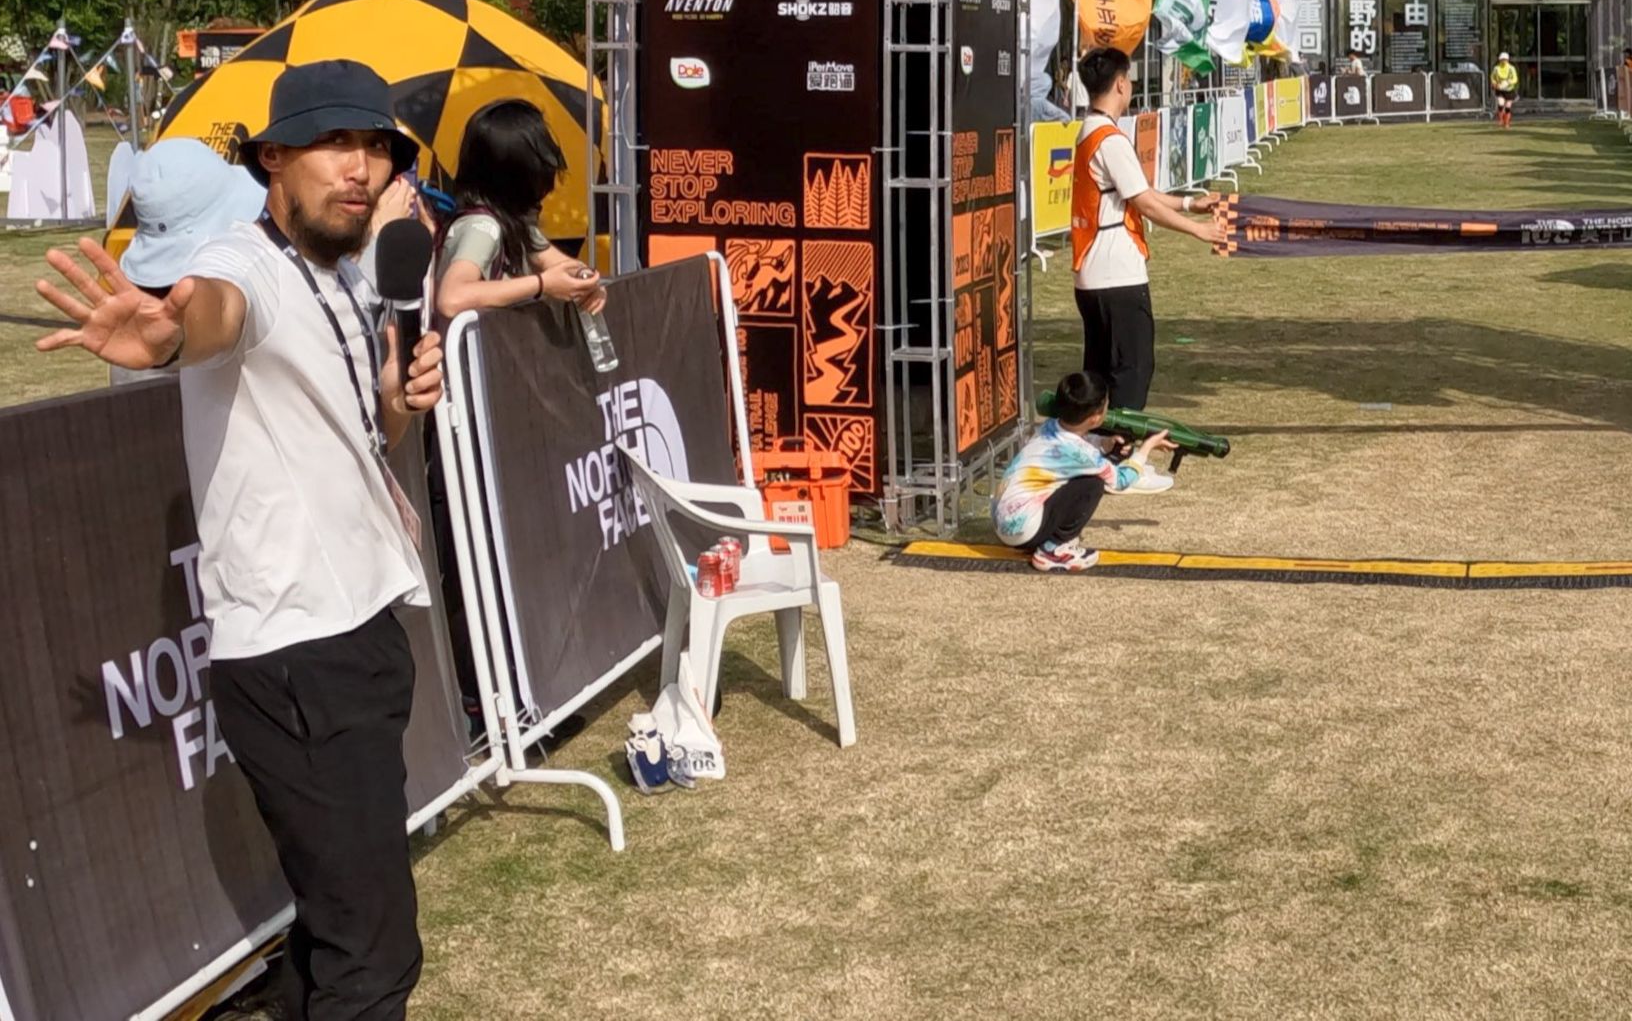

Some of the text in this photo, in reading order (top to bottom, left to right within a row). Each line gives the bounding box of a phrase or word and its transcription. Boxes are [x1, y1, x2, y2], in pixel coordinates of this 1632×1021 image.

[777, 2, 826, 17] SHOKZ
[678, 64, 704, 77] Dole
[210, 122, 235, 136] THE
[650, 149, 733, 174] NEVER
[650, 175, 718, 199] STOP
[650, 200, 795, 227] EXPLORING
[596, 380, 643, 441] THE
[598, 481, 651, 551] FACE
[102, 622, 211, 740] NOR
[172, 700, 236, 791] FA
